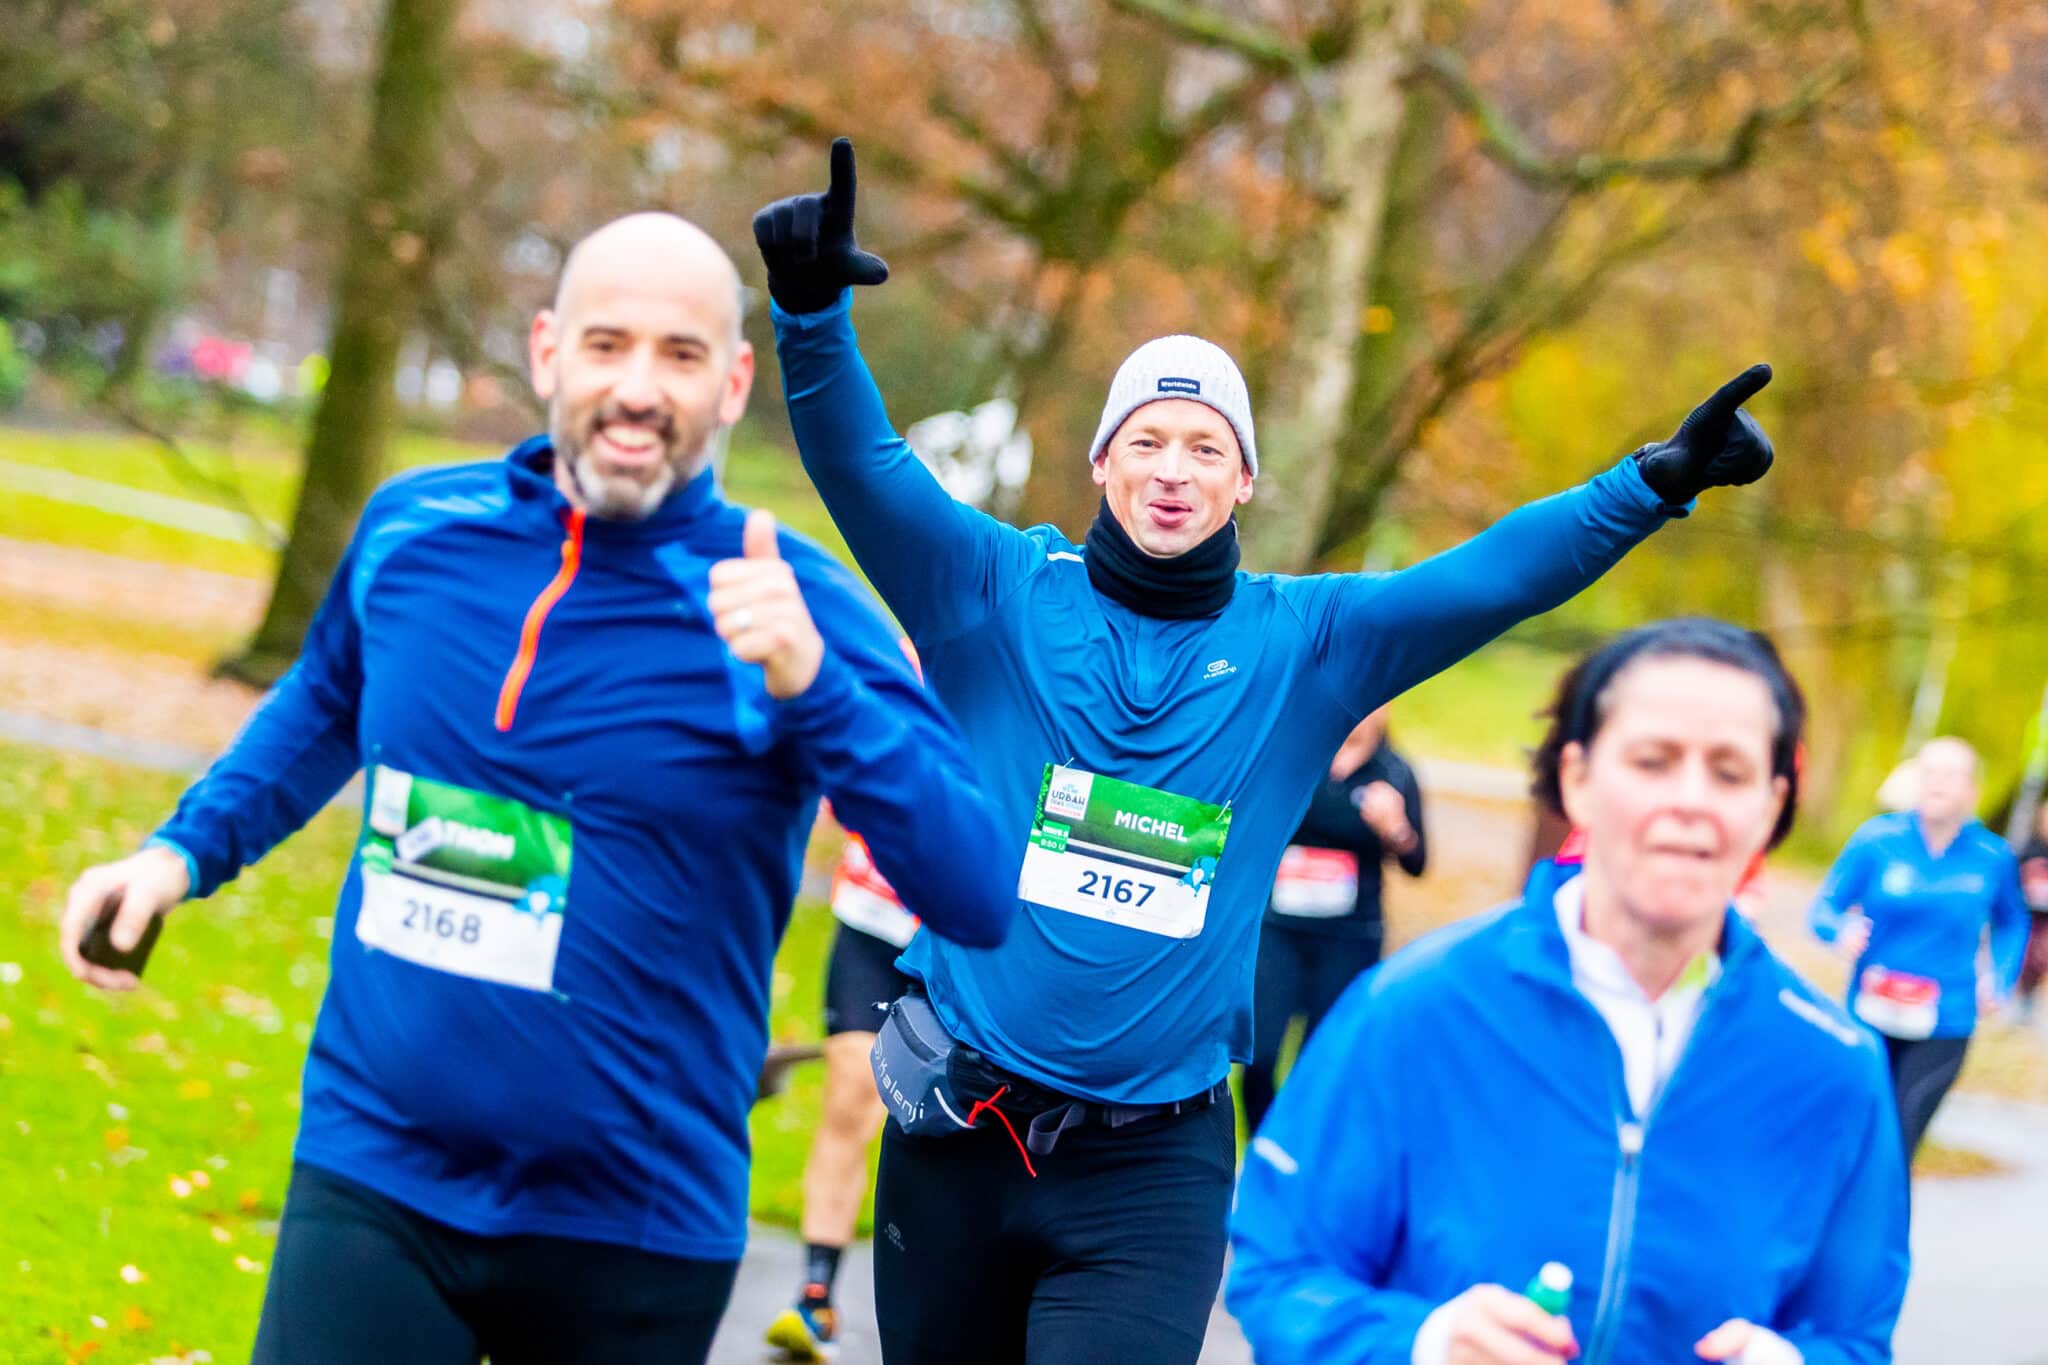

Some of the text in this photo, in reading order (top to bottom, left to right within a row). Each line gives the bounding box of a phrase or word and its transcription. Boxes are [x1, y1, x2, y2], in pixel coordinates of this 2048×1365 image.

[1051, 790, 1085, 806] URBAN
[1115, 809, 1188, 843] MICHEL
[1077, 869, 1156, 908] 2167
[401, 898, 481, 944] 2168
